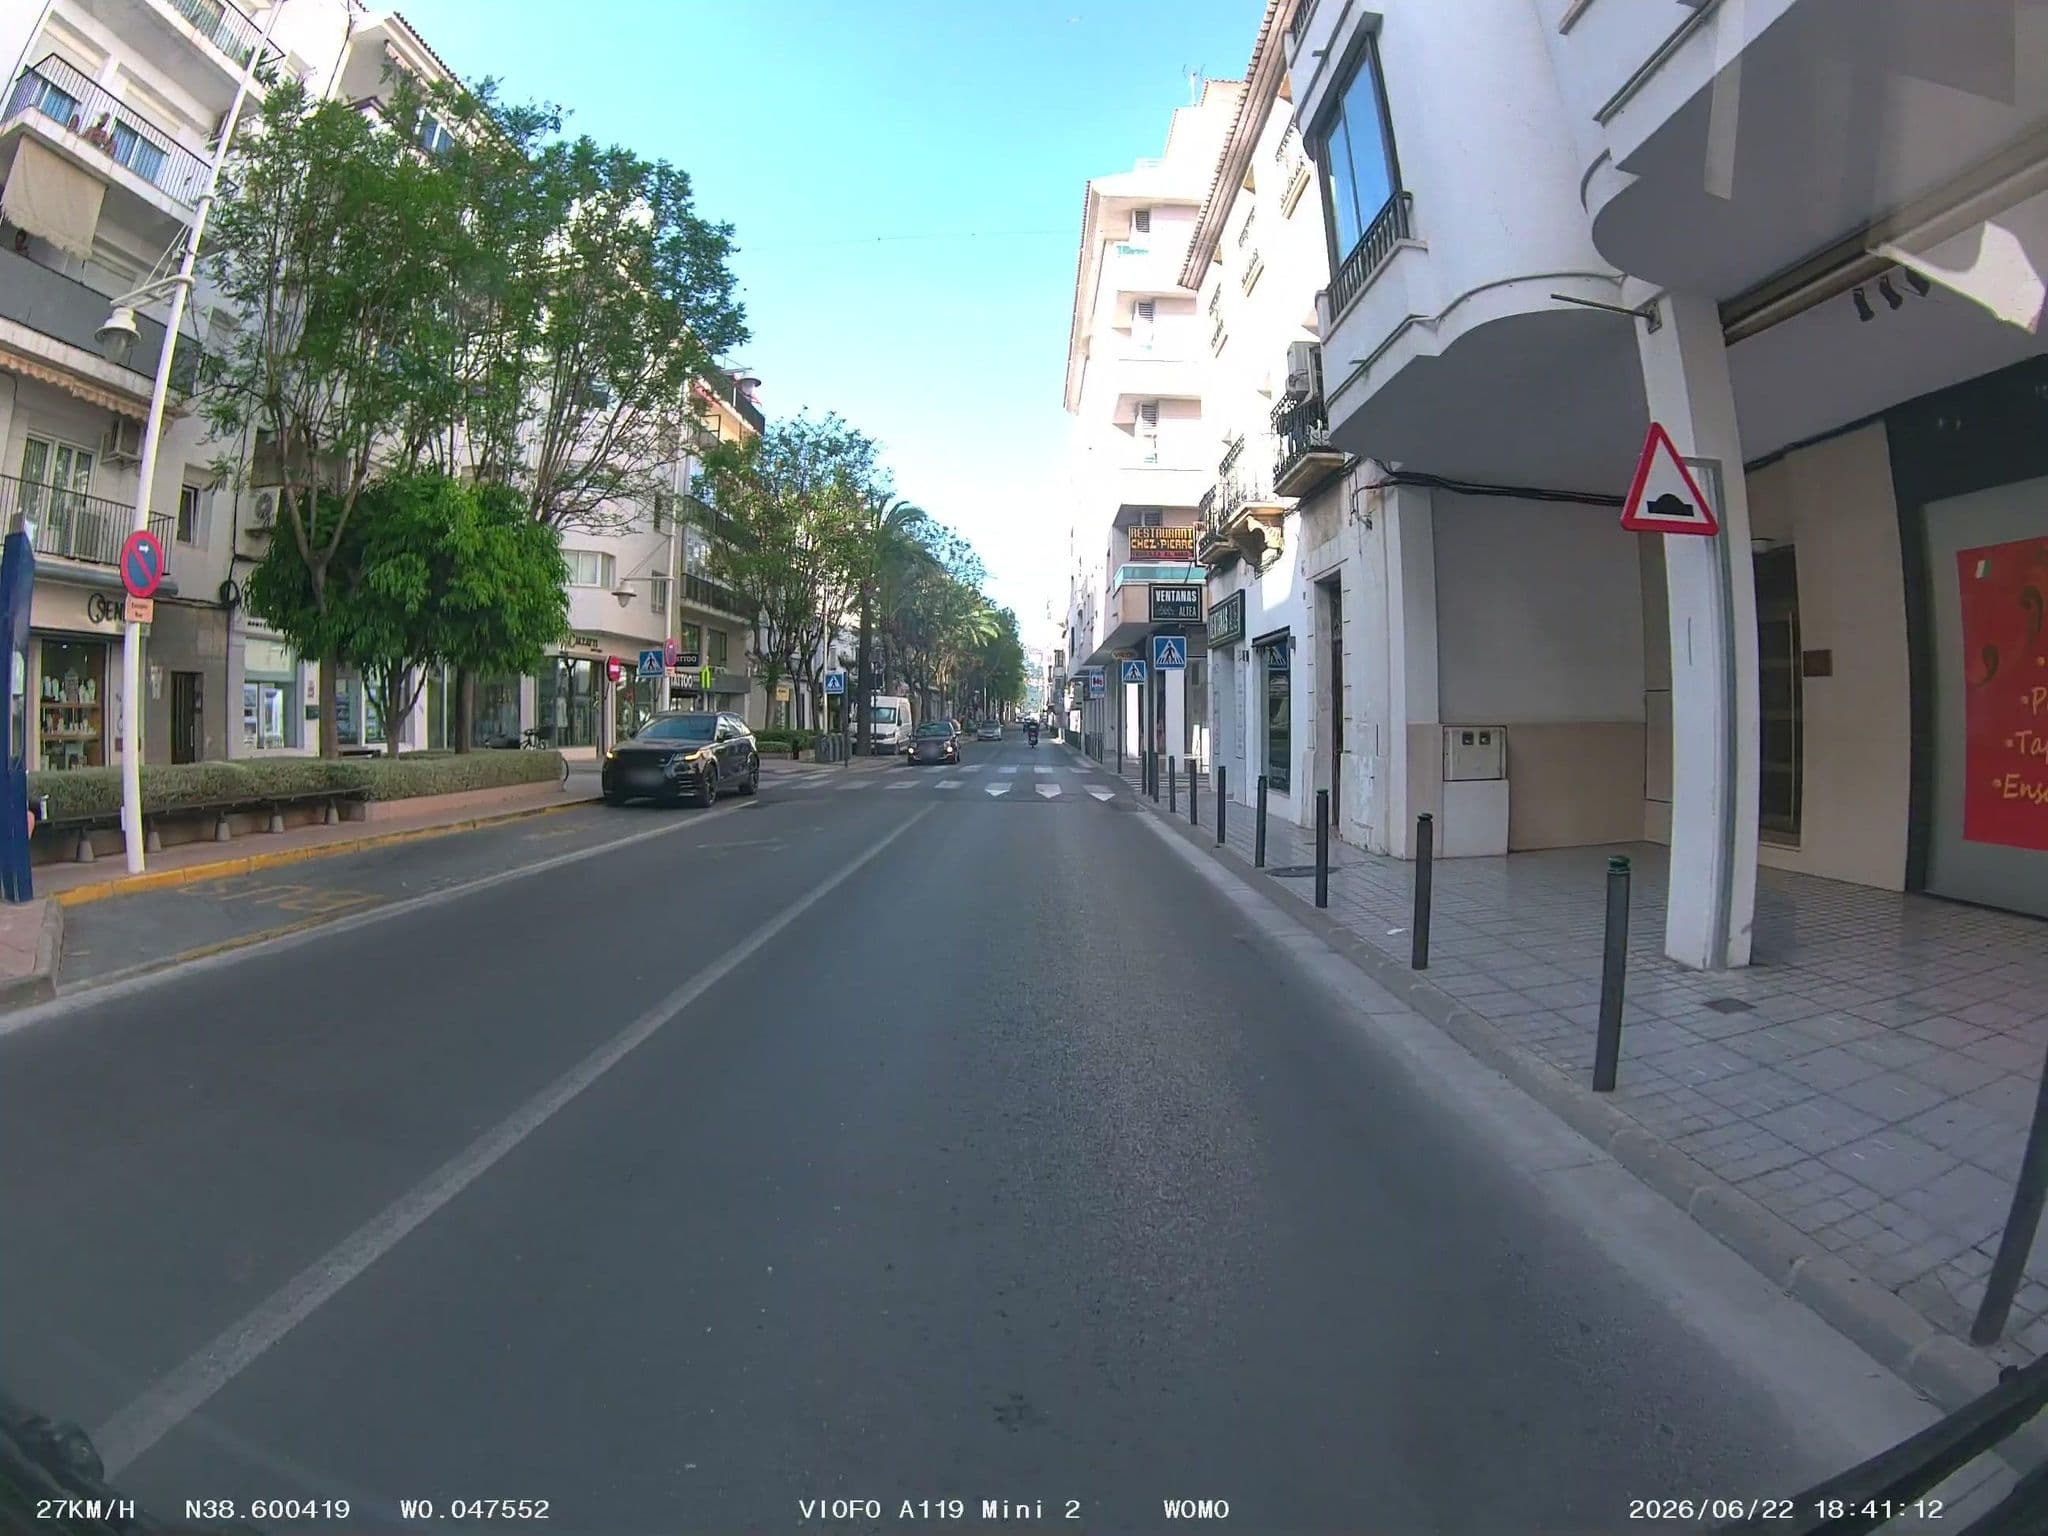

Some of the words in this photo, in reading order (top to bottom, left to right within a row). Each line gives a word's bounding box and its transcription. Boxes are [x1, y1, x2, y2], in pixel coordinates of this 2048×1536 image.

[1131, 527, 1193, 538] RESTAURANT
[1131, 538, 1157, 549] CHEZ
[1160, 538, 1193, 549] PIERRE
[1155, 590, 1197, 602] VENTANAS
[1179, 605, 1197, 617] ALTEA
